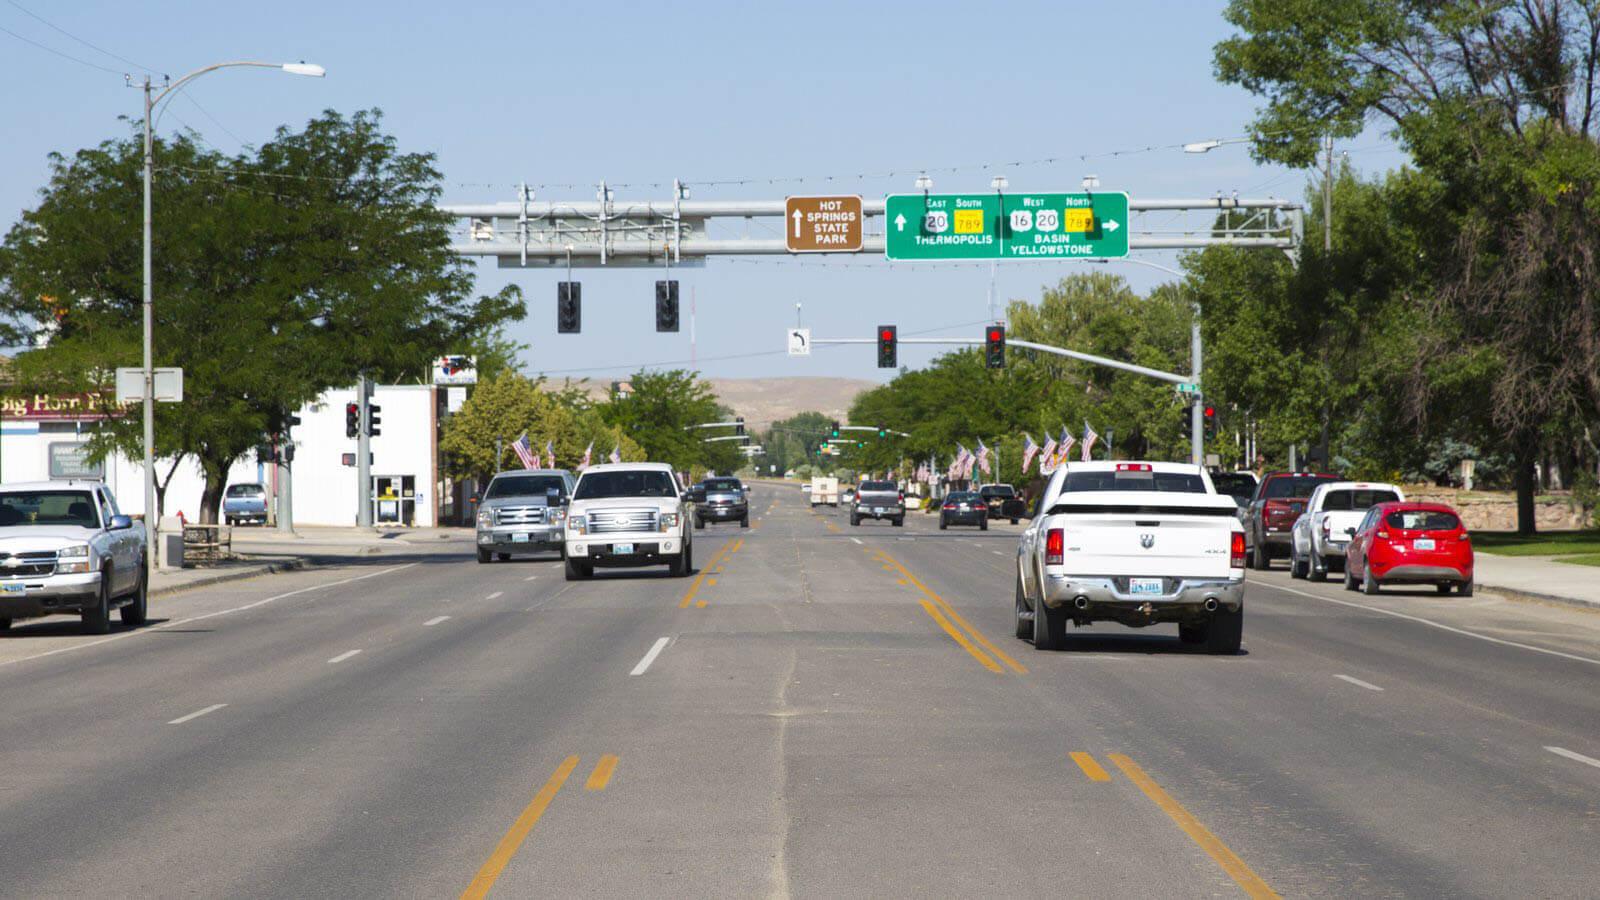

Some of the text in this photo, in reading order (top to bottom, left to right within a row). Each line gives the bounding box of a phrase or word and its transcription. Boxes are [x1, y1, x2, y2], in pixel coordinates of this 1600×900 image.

[820, 201, 842, 211] HOT
[926, 198, 947, 208] EAST
[956, 198, 982, 208] SOUTH
[1023, 197, 1044, 207] WEST
[1066, 197, 1092, 206] NORTH
[807, 211, 856, 222] SPRINGS
[1015, 215, 1028, 226] 16
[1038, 214, 1056, 226] 20
[928, 216, 945, 228] 20
[959, 219, 981, 230] 789
[1069, 218, 1092, 228] 789
[814, 222, 849, 233] STATE
[816, 234, 848, 244] PARK
[915, 235, 992, 245] THERMOPOLIS
[1034, 234, 1070, 244] BASIN
[1011, 245, 1093, 255] YELLOWSTONE
